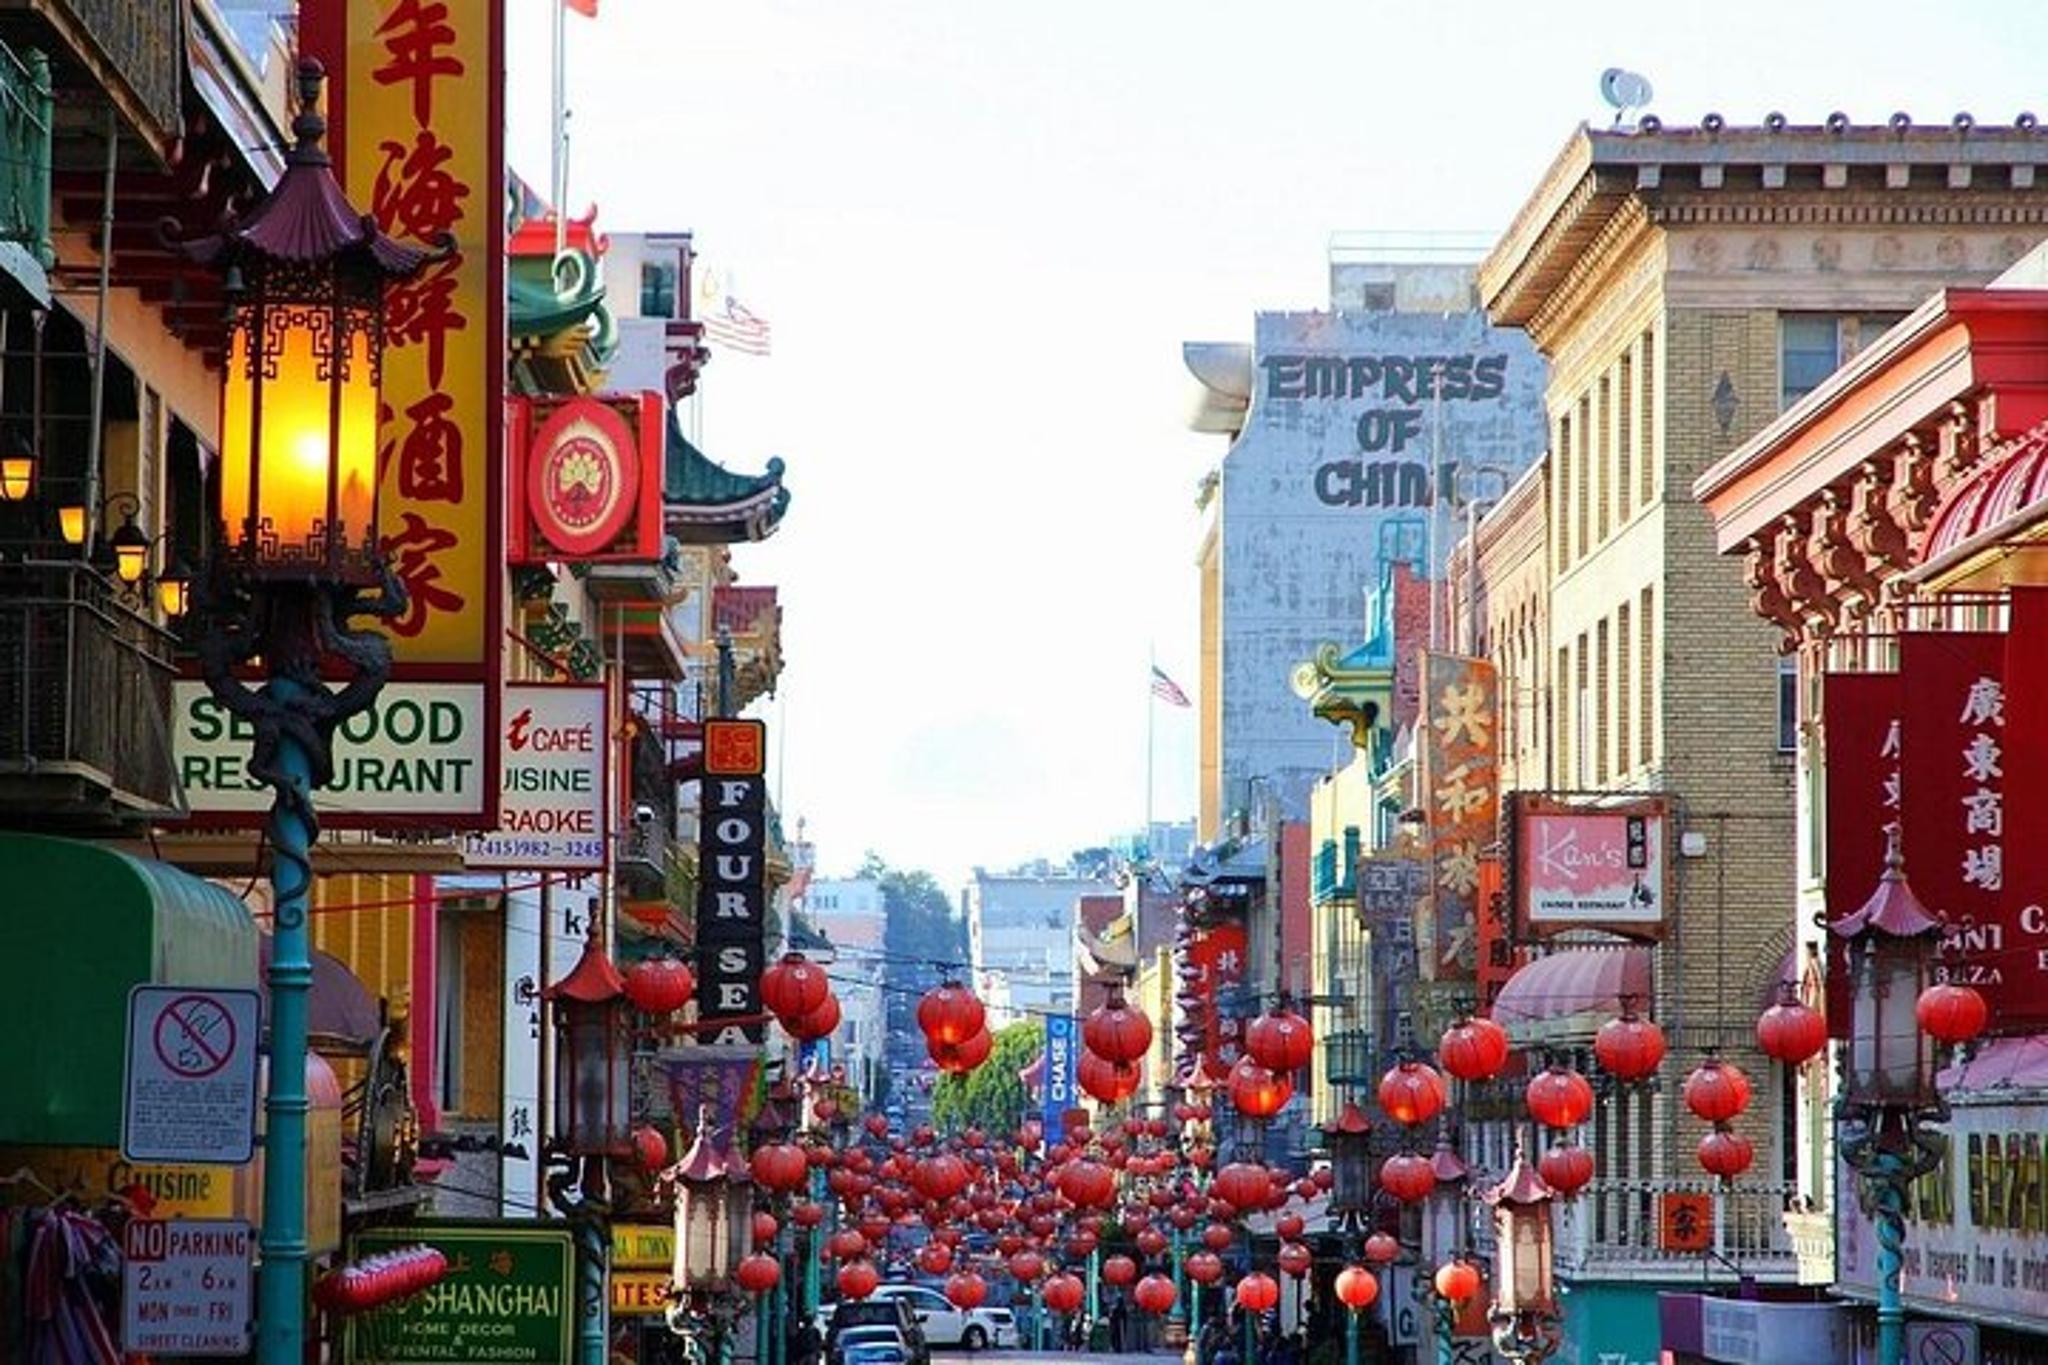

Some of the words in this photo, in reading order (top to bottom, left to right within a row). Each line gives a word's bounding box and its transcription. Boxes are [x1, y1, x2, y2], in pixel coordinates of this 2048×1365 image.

[1260, 354, 1508, 404] EMPRESS
[1357, 409, 1423, 453] OF
[716, 781, 751, 917] FOUR
[1538, 820, 1623, 879] Kan's
[1052, 1037, 1067, 1101] CHASE
[130, 1225, 164, 1257] NO
[170, 1231, 246, 1257] PARKING
[422, 1283, 560, 1316] SHANGHAI
[468, 1347, 536, 1359] FASHION
